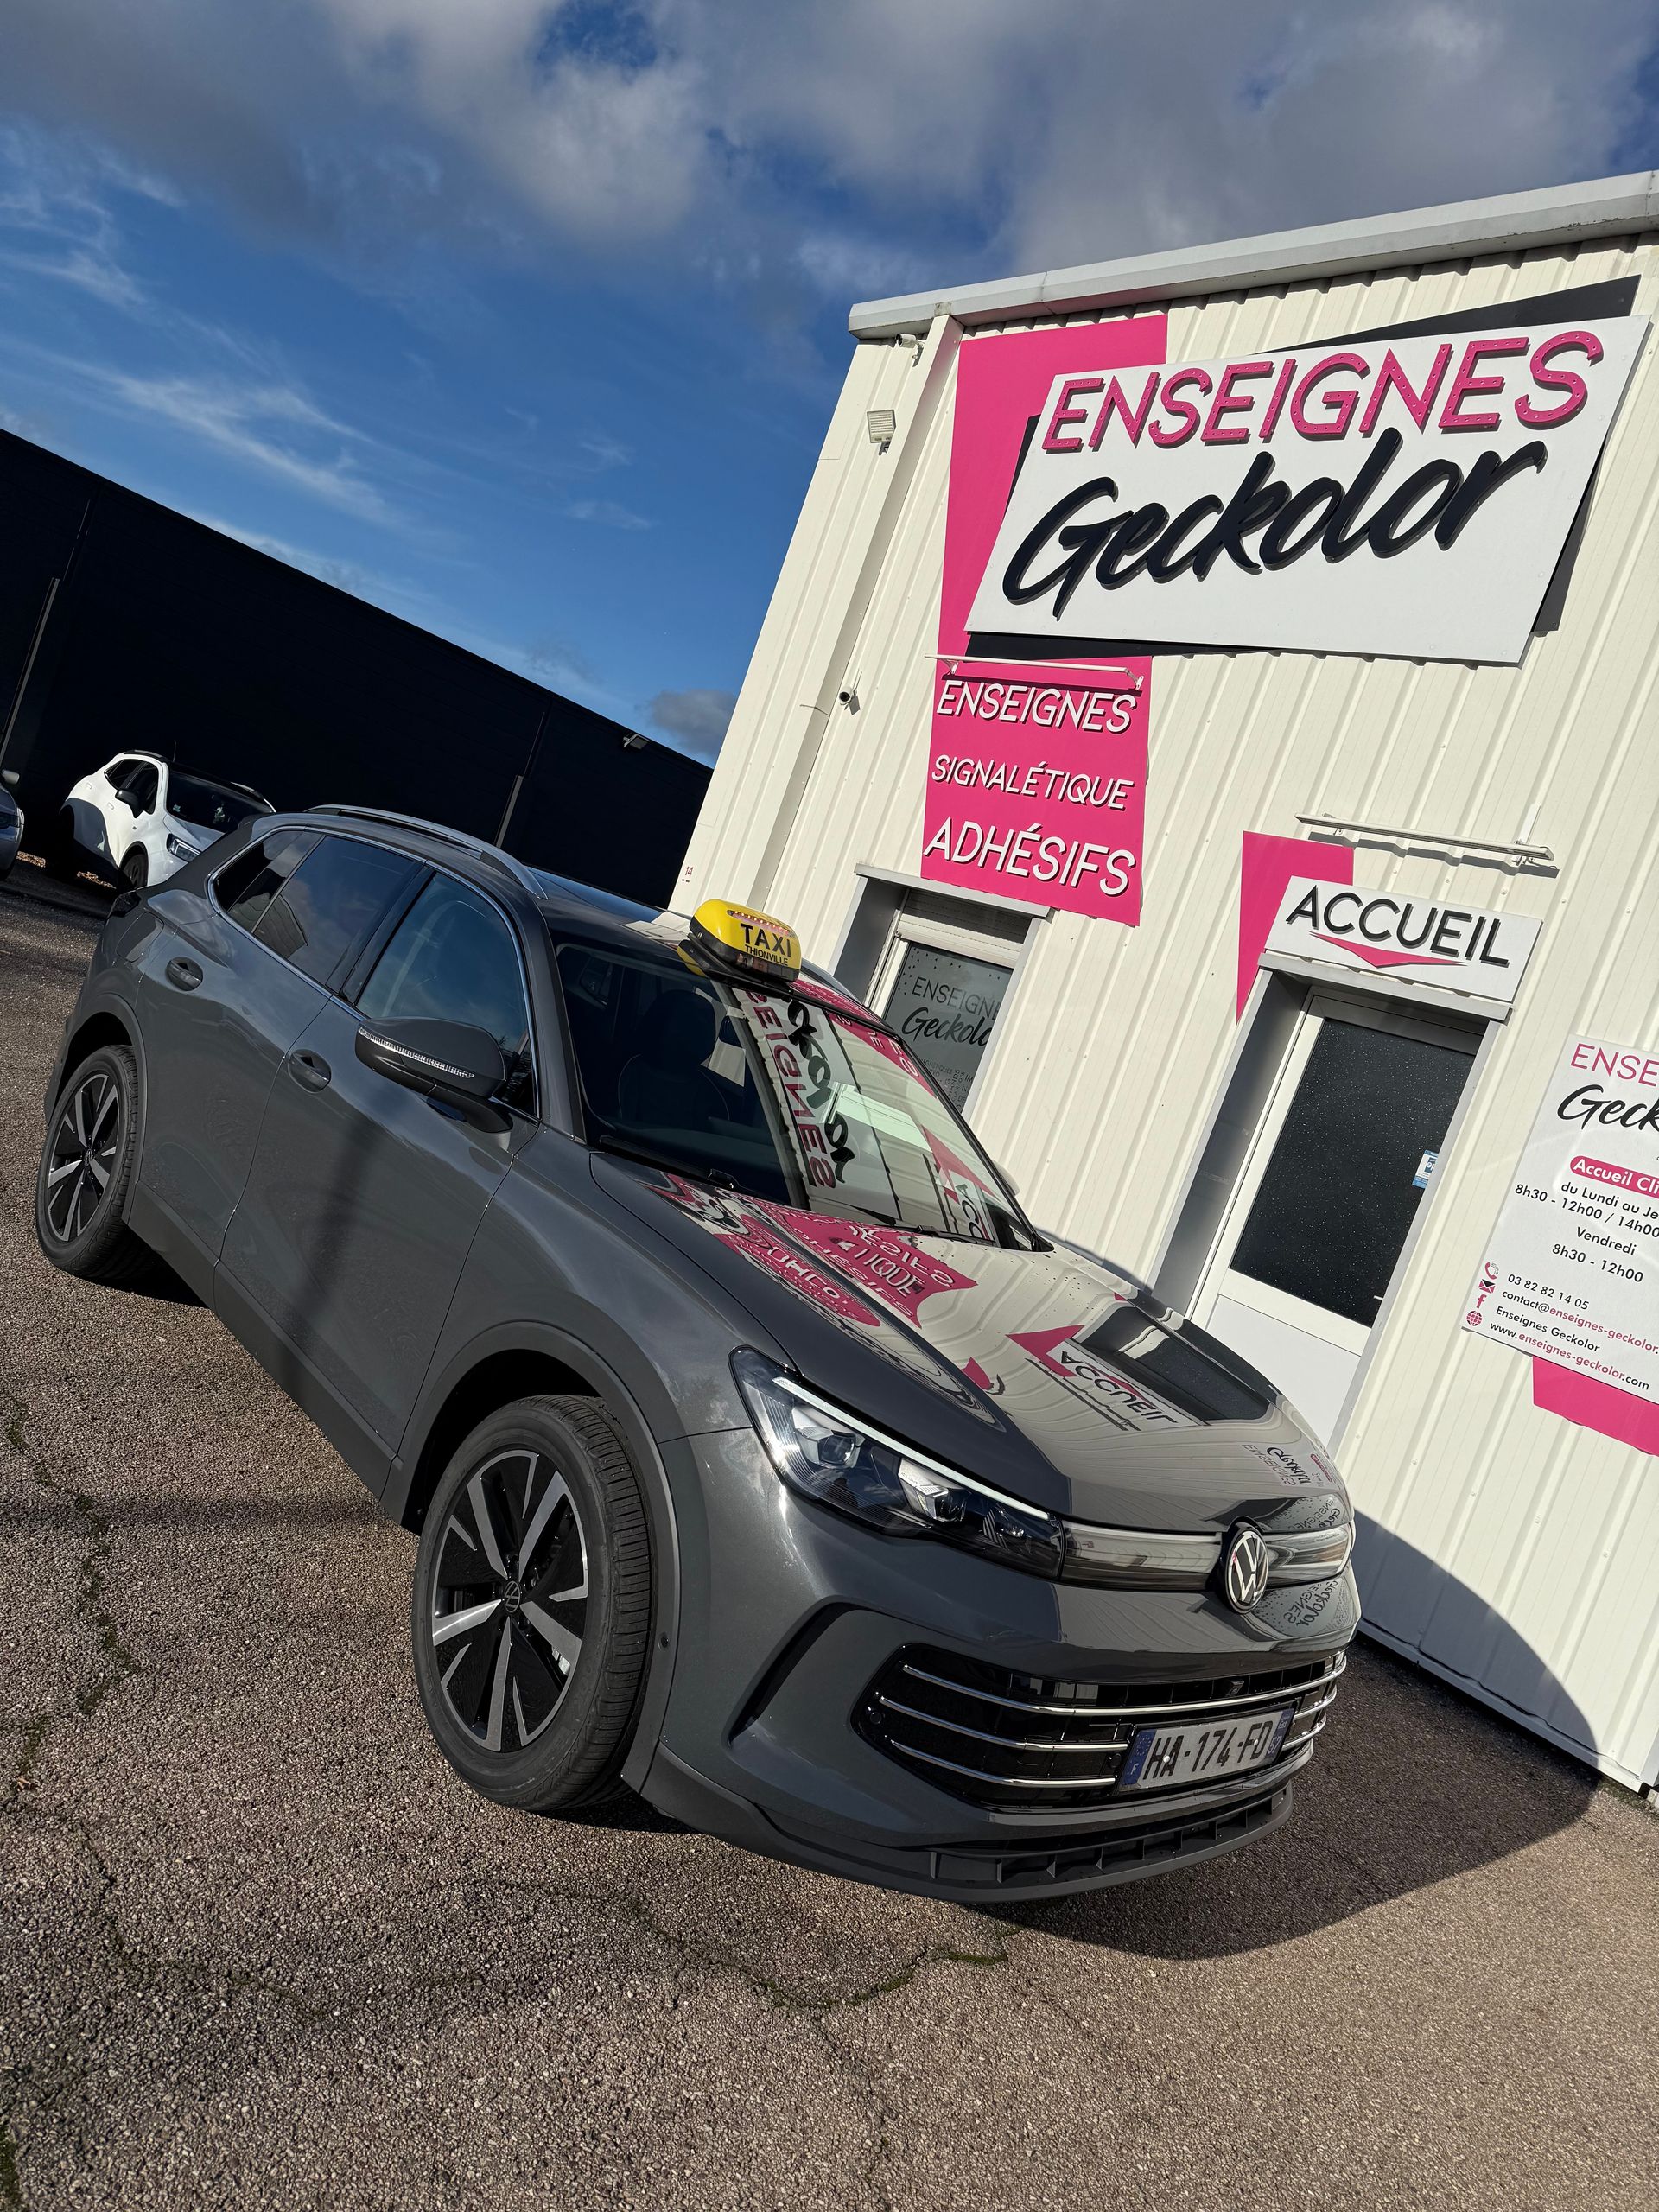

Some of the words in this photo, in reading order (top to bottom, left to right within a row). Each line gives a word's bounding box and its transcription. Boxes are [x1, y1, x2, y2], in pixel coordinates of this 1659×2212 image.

[1040, 330, 1604, 454] ENSEIGNES
[1002, 427, 1548, 621] Geckolor
[936, 679, 1137, 734] ENSEIGNES
[931, 753, 1135, 810] SIGNALÉTIQUE
[923, 816, 1136, 897] ADHÉSIFS
[741, 923, 791, 957] TAXI
[1285, 884, 1510, 968] ACCUEIL
[745, 944, 788, 966] THIONVILLE
[1570, 1043, 1659, 1087] ENSE
[1573, 1159, 1633, 1186] Accueil
[1515, 1184, 1548, 1202] 8h30
[1561, 1198, 1603, 1219] 12h00
[1618, 1216, 1659, 1237] 14h00
[1560, 1181, 1578, 1195] du
[1581, 1187, 1619, 1207] Lundi
[1622, 1202, 1640, 1214] au
[1552, 1243, 1586, 1263] 8h30
[1600, 1259, 1643, 1282] 12h00
[1576, 1226, 1637, 1255] Vendredi
[1508, 1274, 1522, 1286] 03
[1524, 1280, 1537, 1292] 82
[1541, 1286, 1554, 1298] 82
[1559, 1292, 1572, 1304] 14
[1574, 1298, 1590, 1310] 05
[1496, 1306, 1548, 1332] Enseignes
[1551, 1327, 1600, 1352] Geckolor
[1490, 1322, 1649, 1390] www.enseignes-geckolor.com
[1130, 1763, 1139, 1775] F
[1142, 1720, 1274, 1780] HA-174-FD
